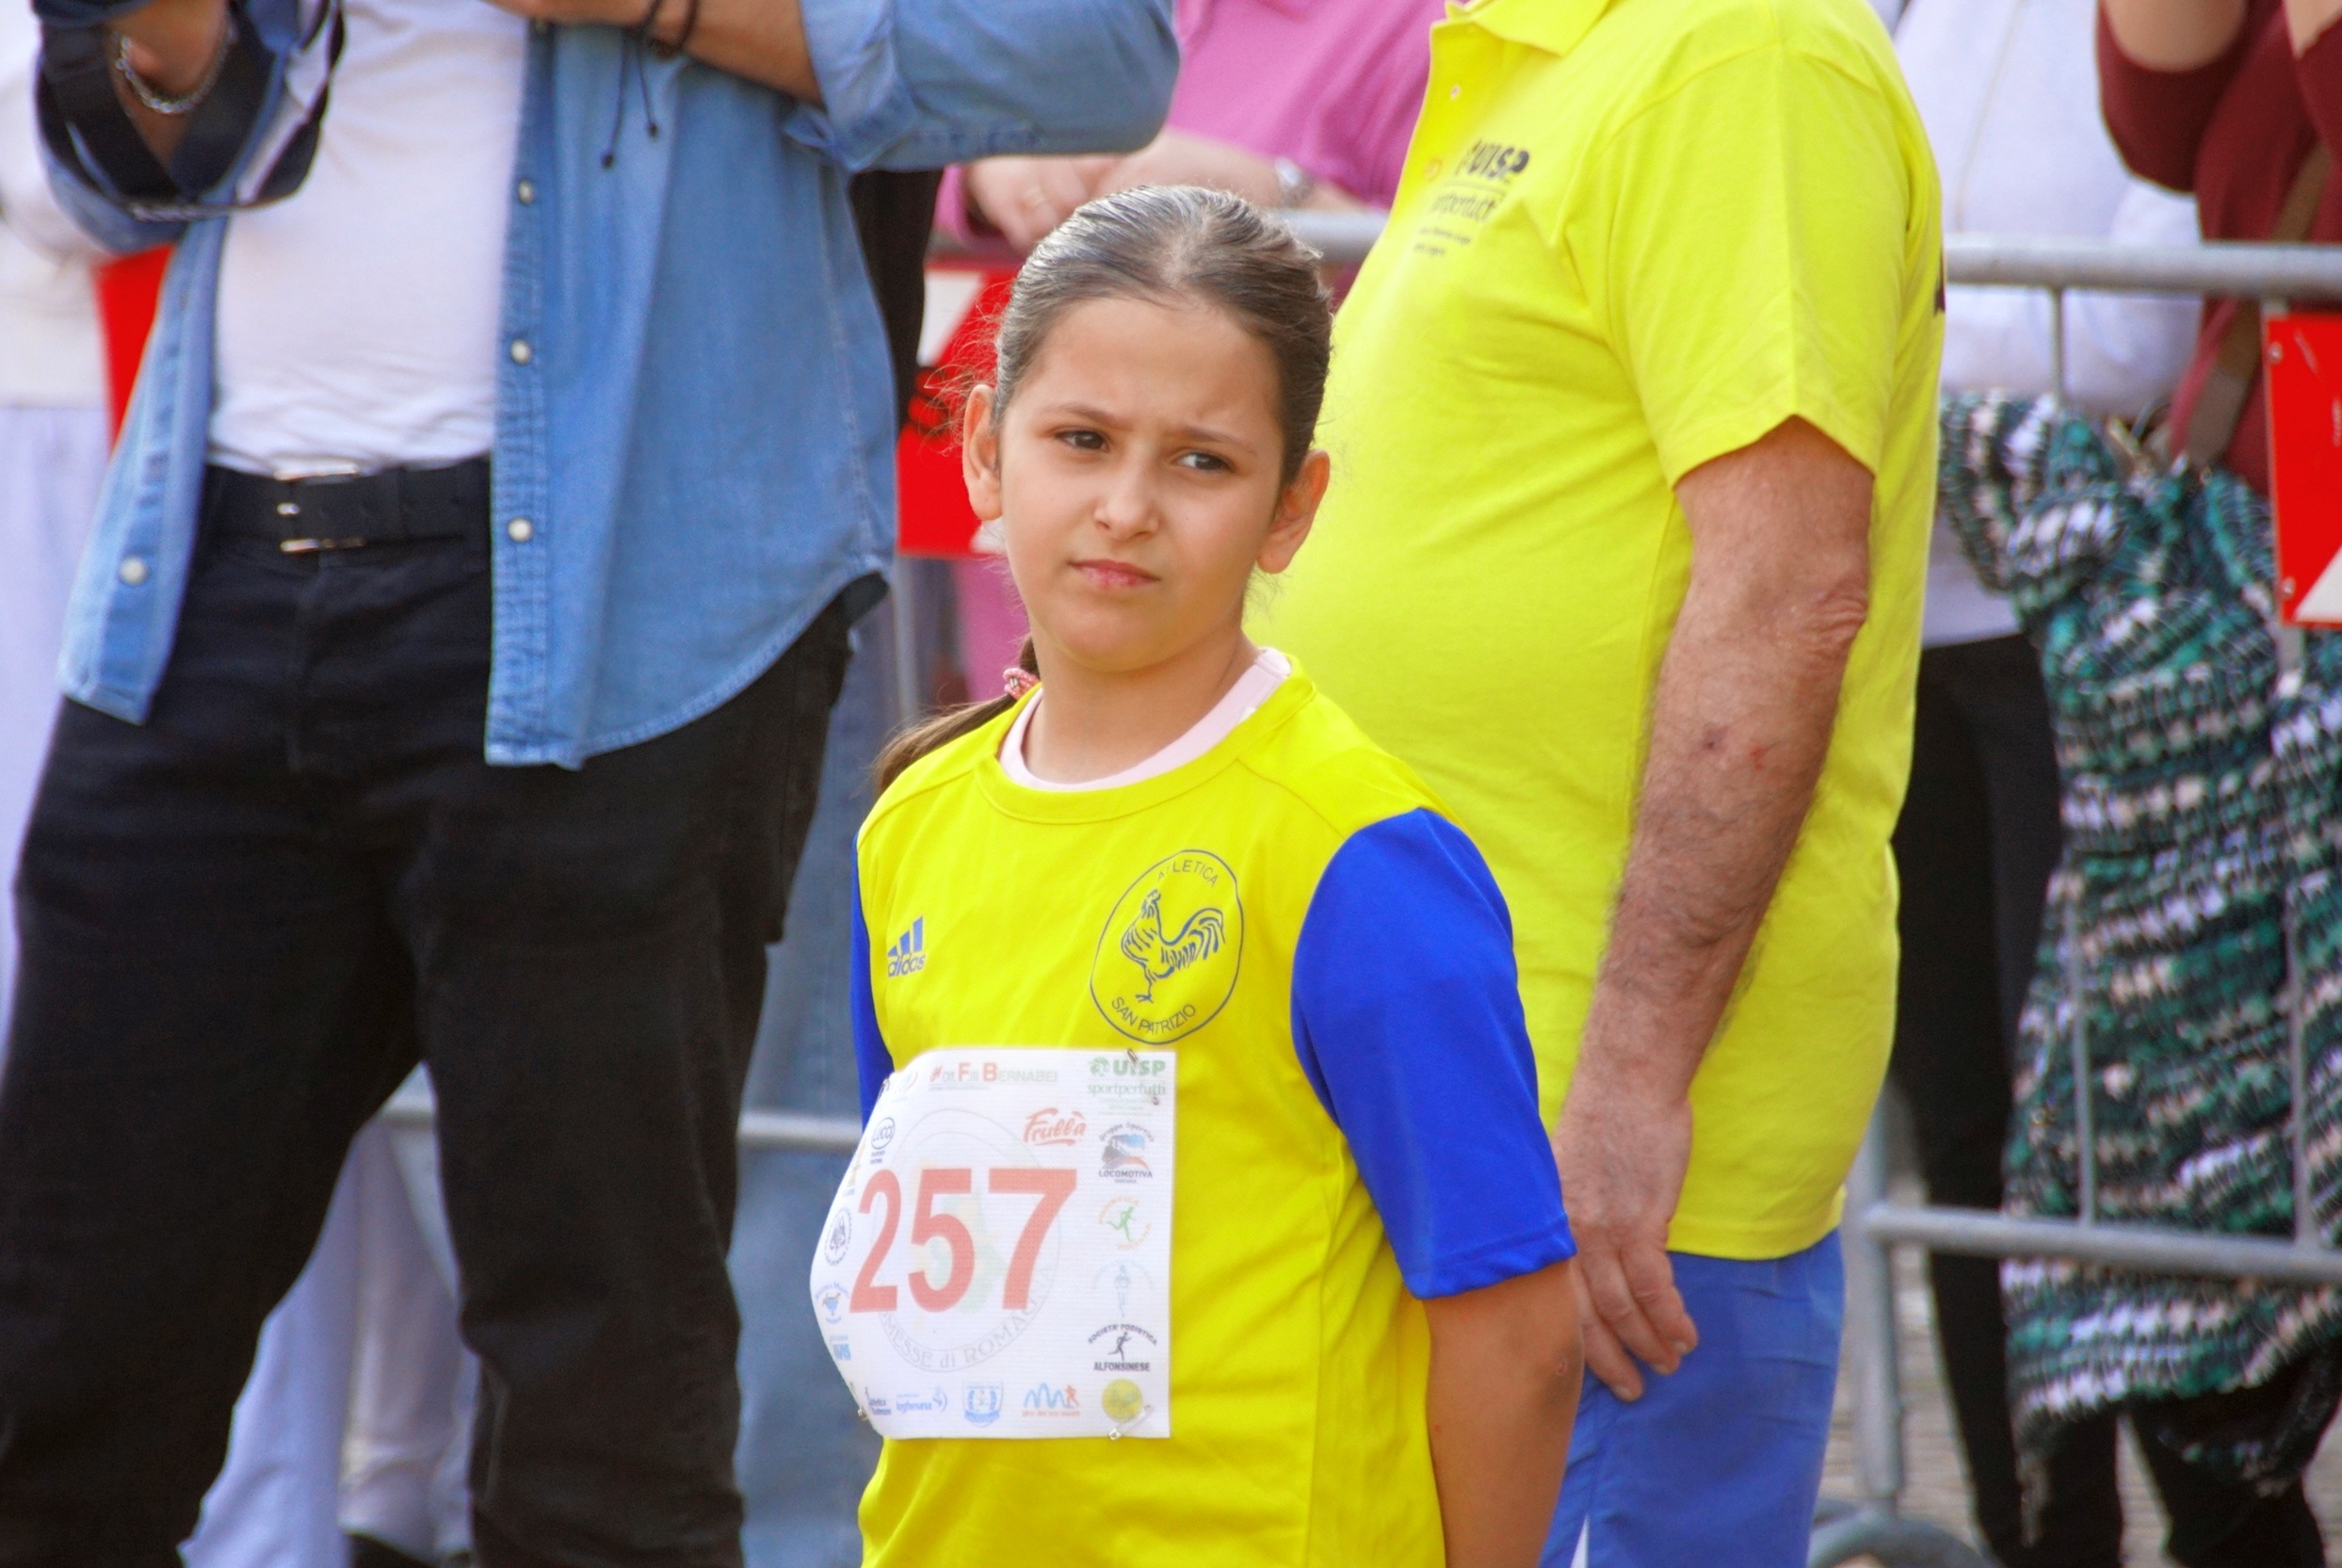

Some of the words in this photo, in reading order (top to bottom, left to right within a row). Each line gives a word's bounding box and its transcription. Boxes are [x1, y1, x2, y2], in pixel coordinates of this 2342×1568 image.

[888, 953, 926, 978] adidas
[1111, 996, 1139, 1026] SAN
[1138, 1003, 1196, 1035] PATRIZIO
[982, 1062, 1058, 1083] BERNABEI
[1113, 1059, 1166, 1076] UISP
[1098, 1170, 1153, 1178] LOCOMOTIVA
[849, 1169, 1077, 1314] 257
[1121, 1323, 1157, 1346] PODISTICA
[1093, 1362, 1151, 1371] ALFONSINESE
